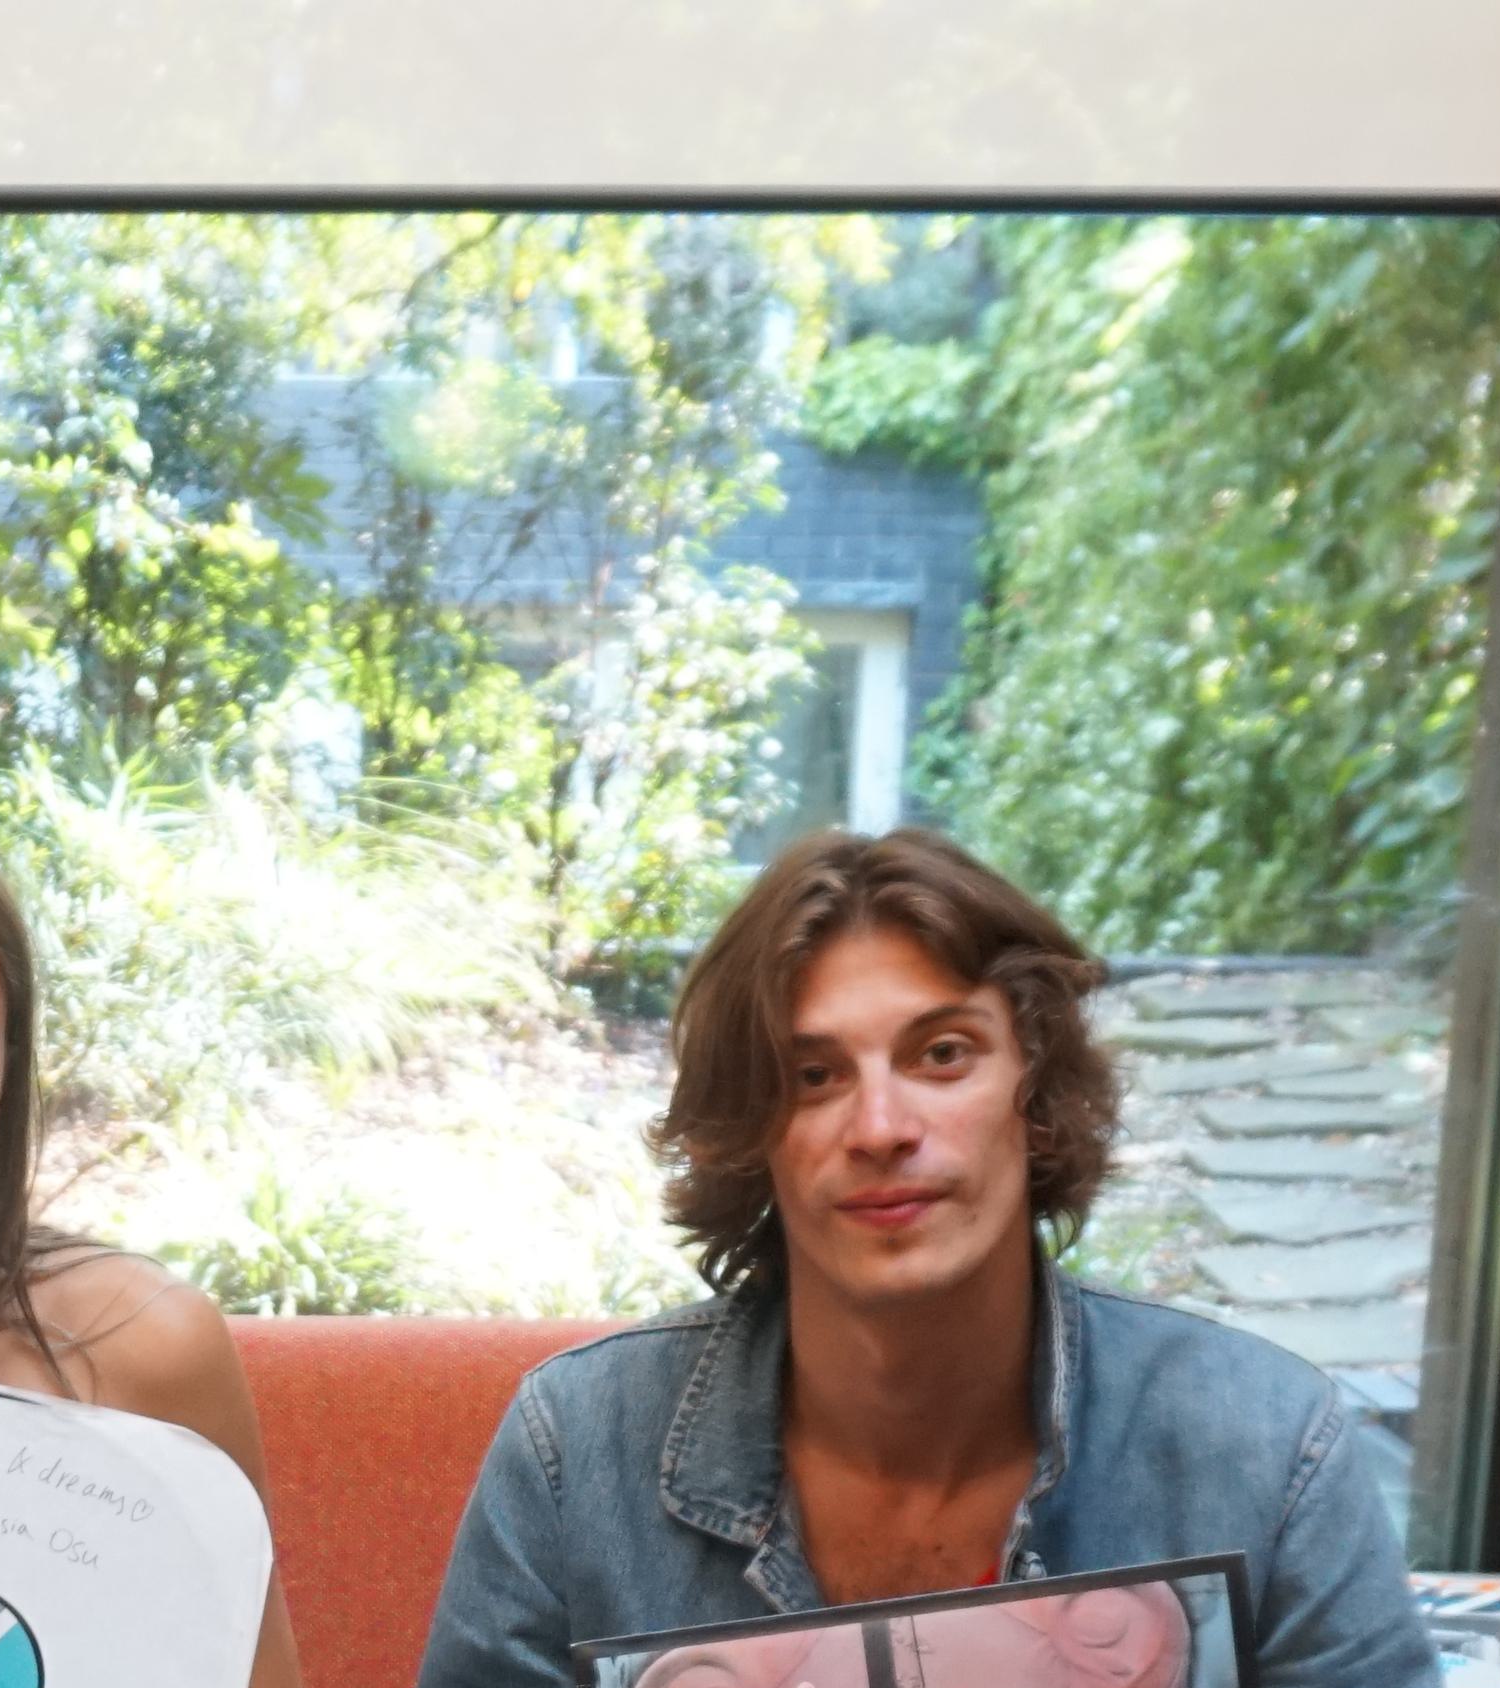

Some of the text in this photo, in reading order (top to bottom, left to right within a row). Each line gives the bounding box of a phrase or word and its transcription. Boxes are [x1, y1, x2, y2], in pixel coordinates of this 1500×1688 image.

[7, 1446, 33, 1474] &
[38, 1457, 125, 1514] dreams
[49, 1528, 99, 1568] Osu
